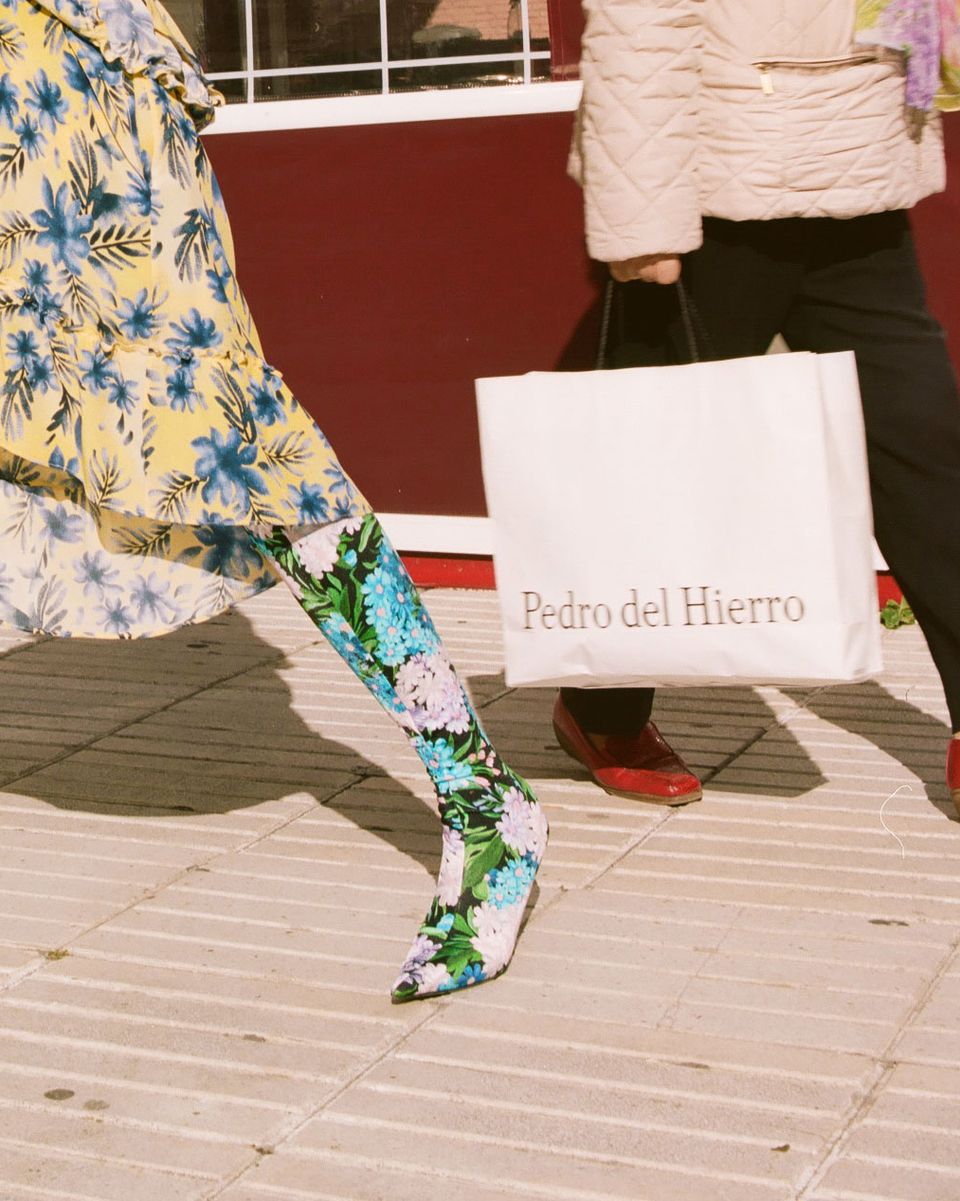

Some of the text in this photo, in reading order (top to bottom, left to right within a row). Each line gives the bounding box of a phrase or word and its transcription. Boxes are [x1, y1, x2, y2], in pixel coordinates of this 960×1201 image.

[520, 585, 806, 630] Pedro del Hierro
